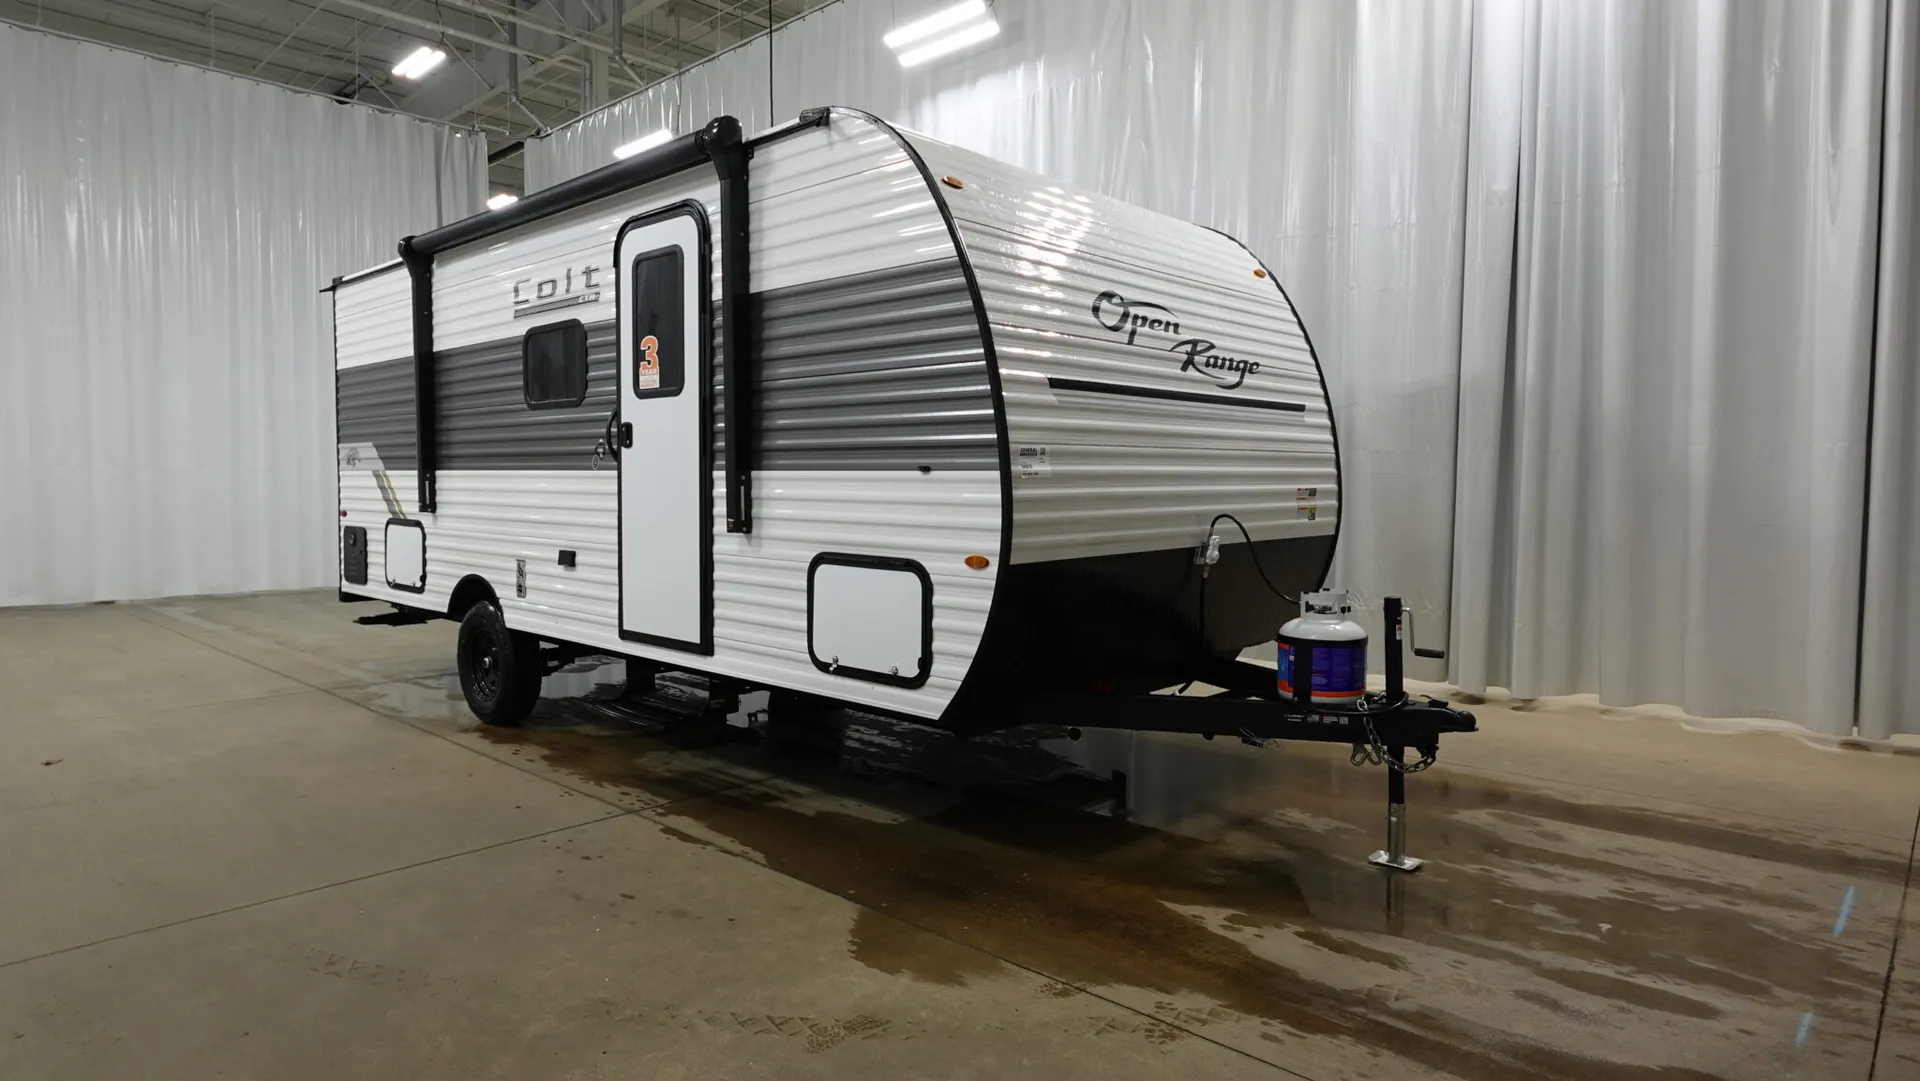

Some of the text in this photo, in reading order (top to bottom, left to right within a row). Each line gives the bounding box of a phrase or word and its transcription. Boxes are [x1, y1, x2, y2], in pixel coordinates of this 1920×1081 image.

[513, 266, 600, 304] Colt
[1091, 290, 1182, 345] Open
[640, 335, 659, 369] 3
[1168, 338, 1261, 390] Range
